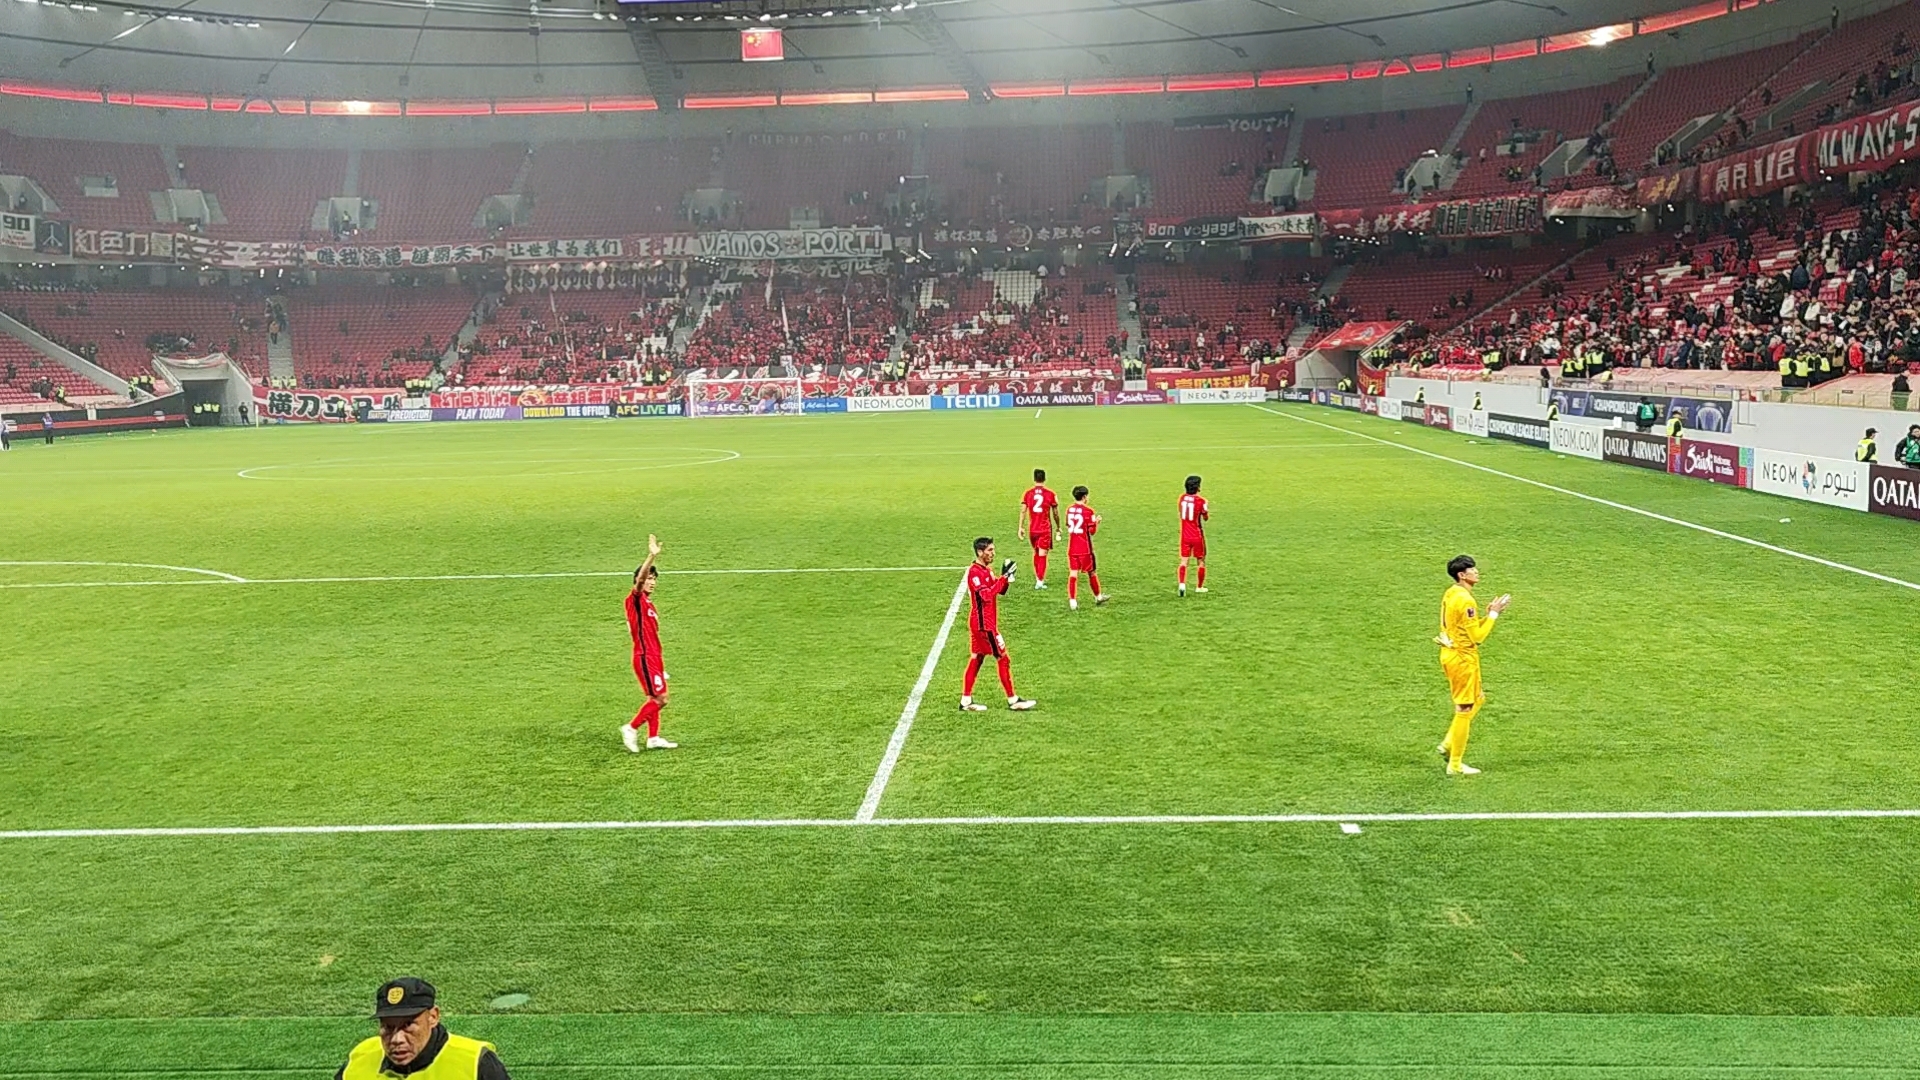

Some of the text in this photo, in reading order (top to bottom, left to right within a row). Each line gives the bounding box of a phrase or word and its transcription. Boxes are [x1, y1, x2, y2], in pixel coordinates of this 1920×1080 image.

[1818, 112, 1900, 168] ALWAYS
[700, 231, 780, 258] VAMOS
[854, 397, 925, 409] NEOM.COM
[943, 395, 1000, 408] TECNO
[1016, 394, 1093, 405] QATAR AIRWAYS
[1187, 392, 1216, 400] NEOM
[456, 408, 506, 420] PLAY TODAY
[523, 405, 610, 418] DOWNLOAD THE OFFICIA
[616, 404, 639, 415] AFC
[640, 404, 666, 415] LIVE
[1515, 423, 1534, 439] LEAGUE
[1534, 426, 1549, 442] ELITE
[1553, 426, 1599, 452] NEOM.COM
[1604, 436, 1666, 464] QATAR AIRWAYS
[1684, 443, 1714, 474] Saudi
[1762, 461, 1798, 484] NEOM
[1822, 470, 1857, 498] نيوم
[1873, 476, 1920, 508] QATA
[1033, 494, 1043, 512] 2
[1181, 501, 1194, 520] 11
[1067, 513, 1084, 533] 52
